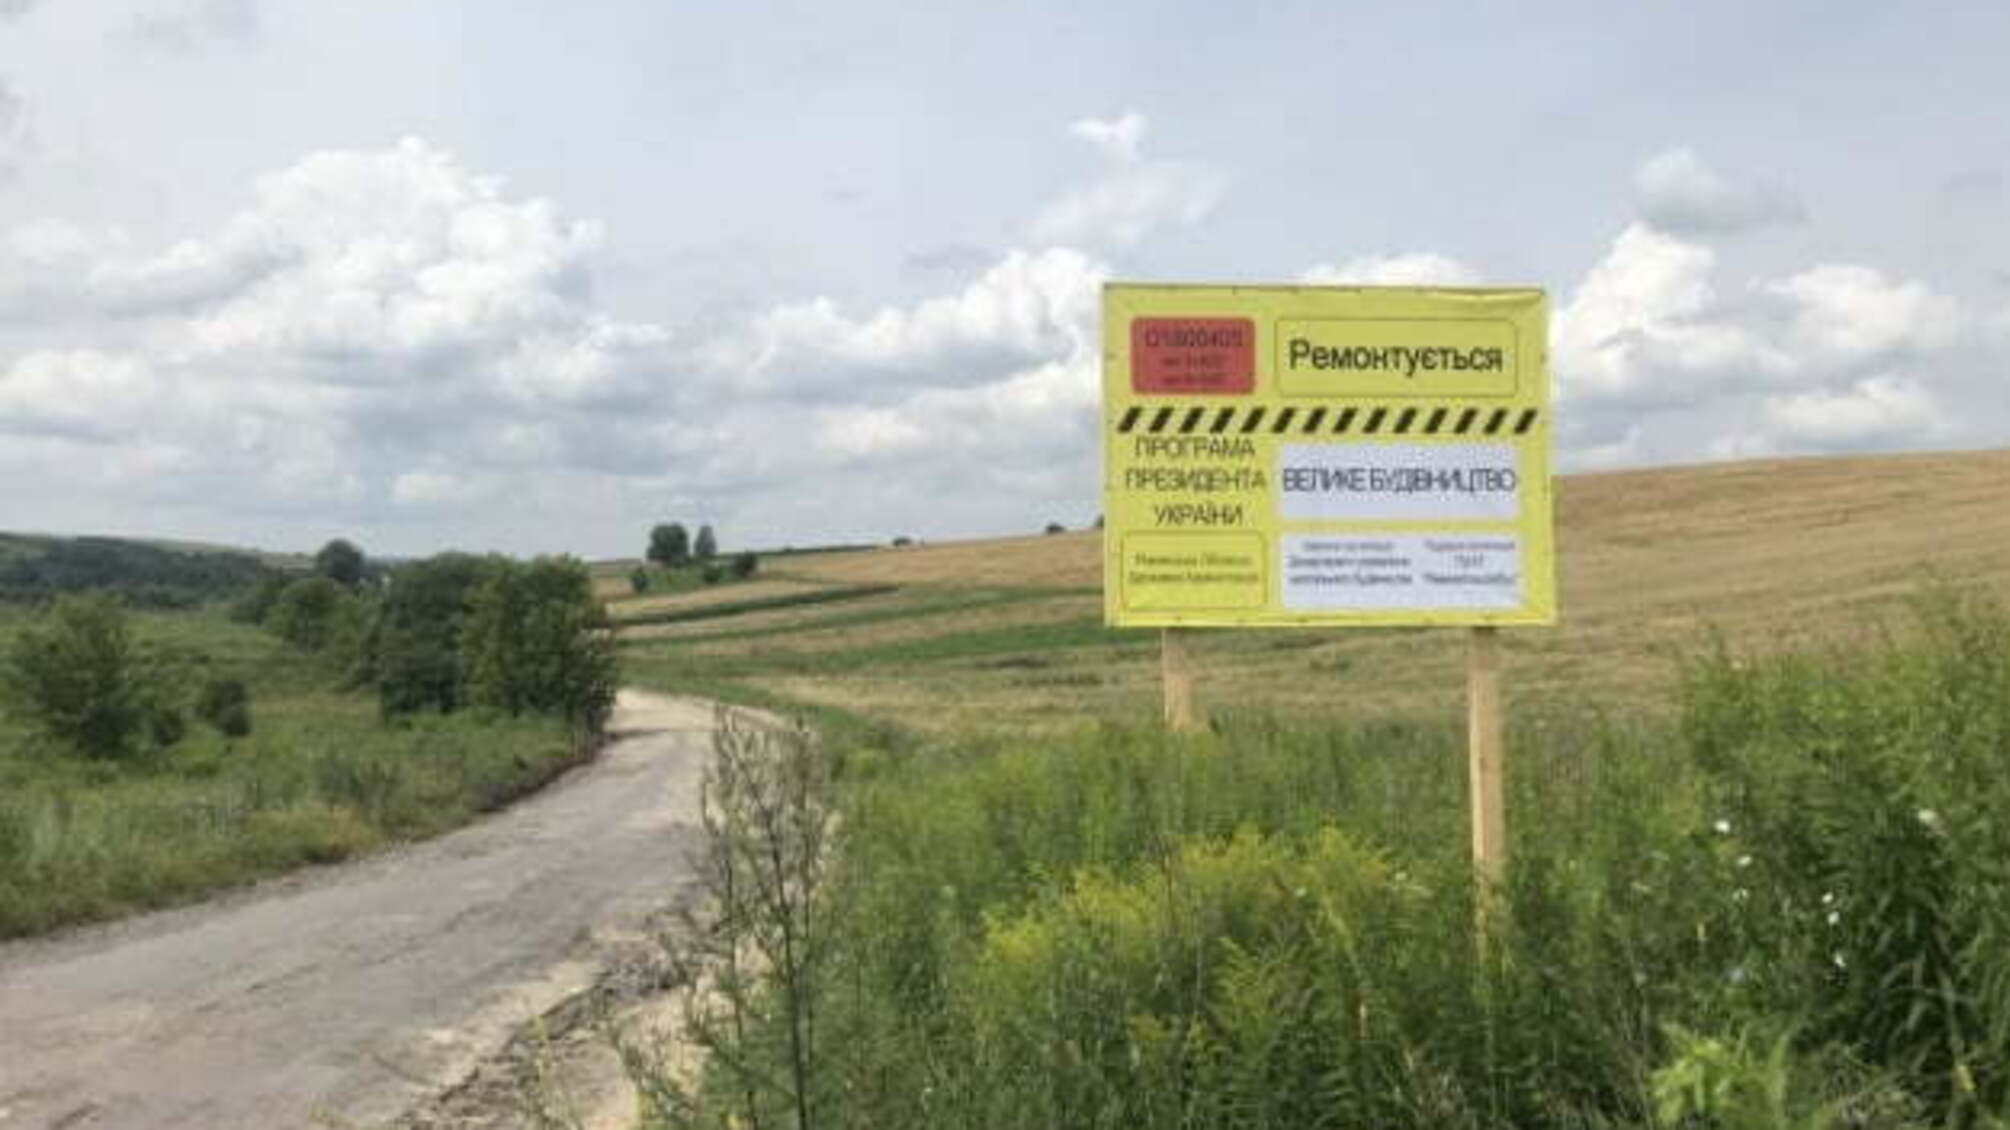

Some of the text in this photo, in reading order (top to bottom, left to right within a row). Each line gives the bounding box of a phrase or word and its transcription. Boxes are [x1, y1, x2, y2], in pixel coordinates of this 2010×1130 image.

[1288, 338, 1503, 377] Ремонтується
[1135, 436, 1256, 458] ПРОГРАМА
[1125, 468, 1267, 491] ПРЕЗИДЕНТА
[1283, 467, 1517, 494] ВЕЛИКЕ БУДІВНИЦТВО
[1153, 503, 1243, 526] УКРАЇНИ
